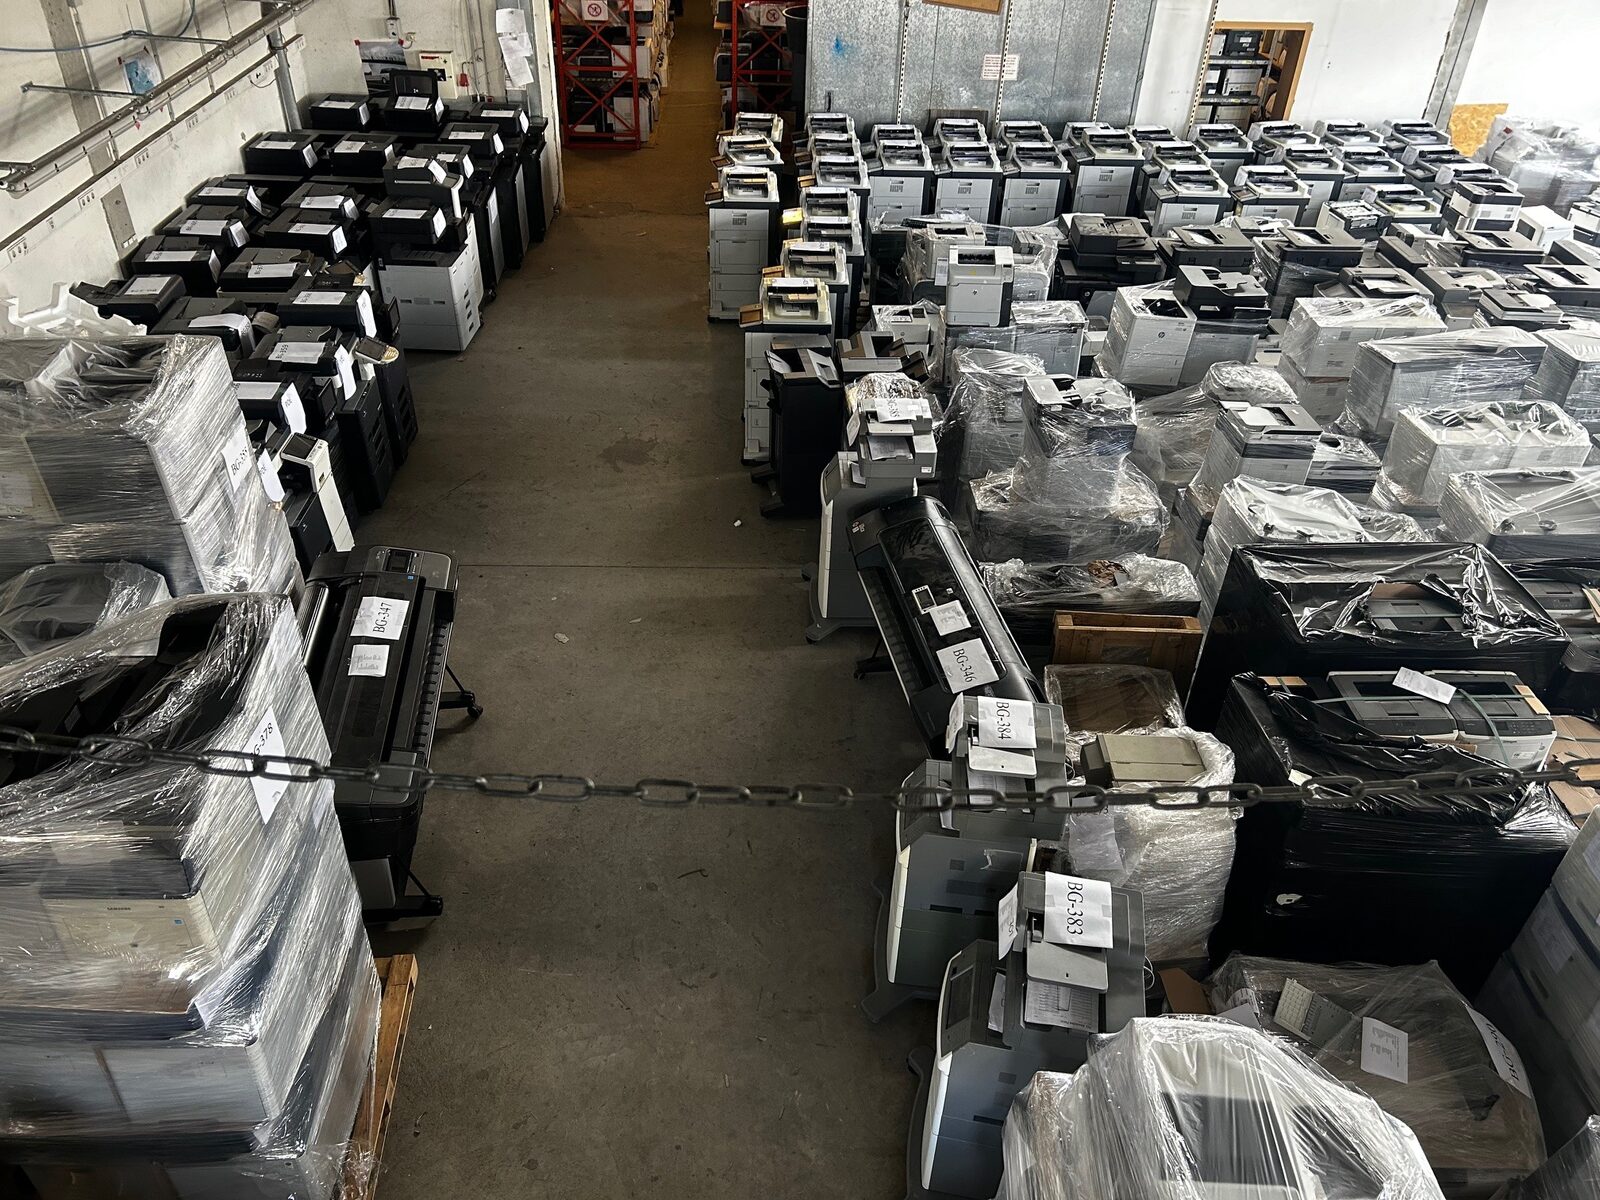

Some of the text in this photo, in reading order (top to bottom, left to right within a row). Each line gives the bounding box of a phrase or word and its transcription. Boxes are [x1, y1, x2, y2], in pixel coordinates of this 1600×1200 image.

[373, 602, 392, 633] BG-347
[953, 648, 977, 683] BG-346
[996, 701, 1012, 740] BG-384
[250, 722, 274, 764] G-378
[1066, 881, 1084, 936] BG-383
